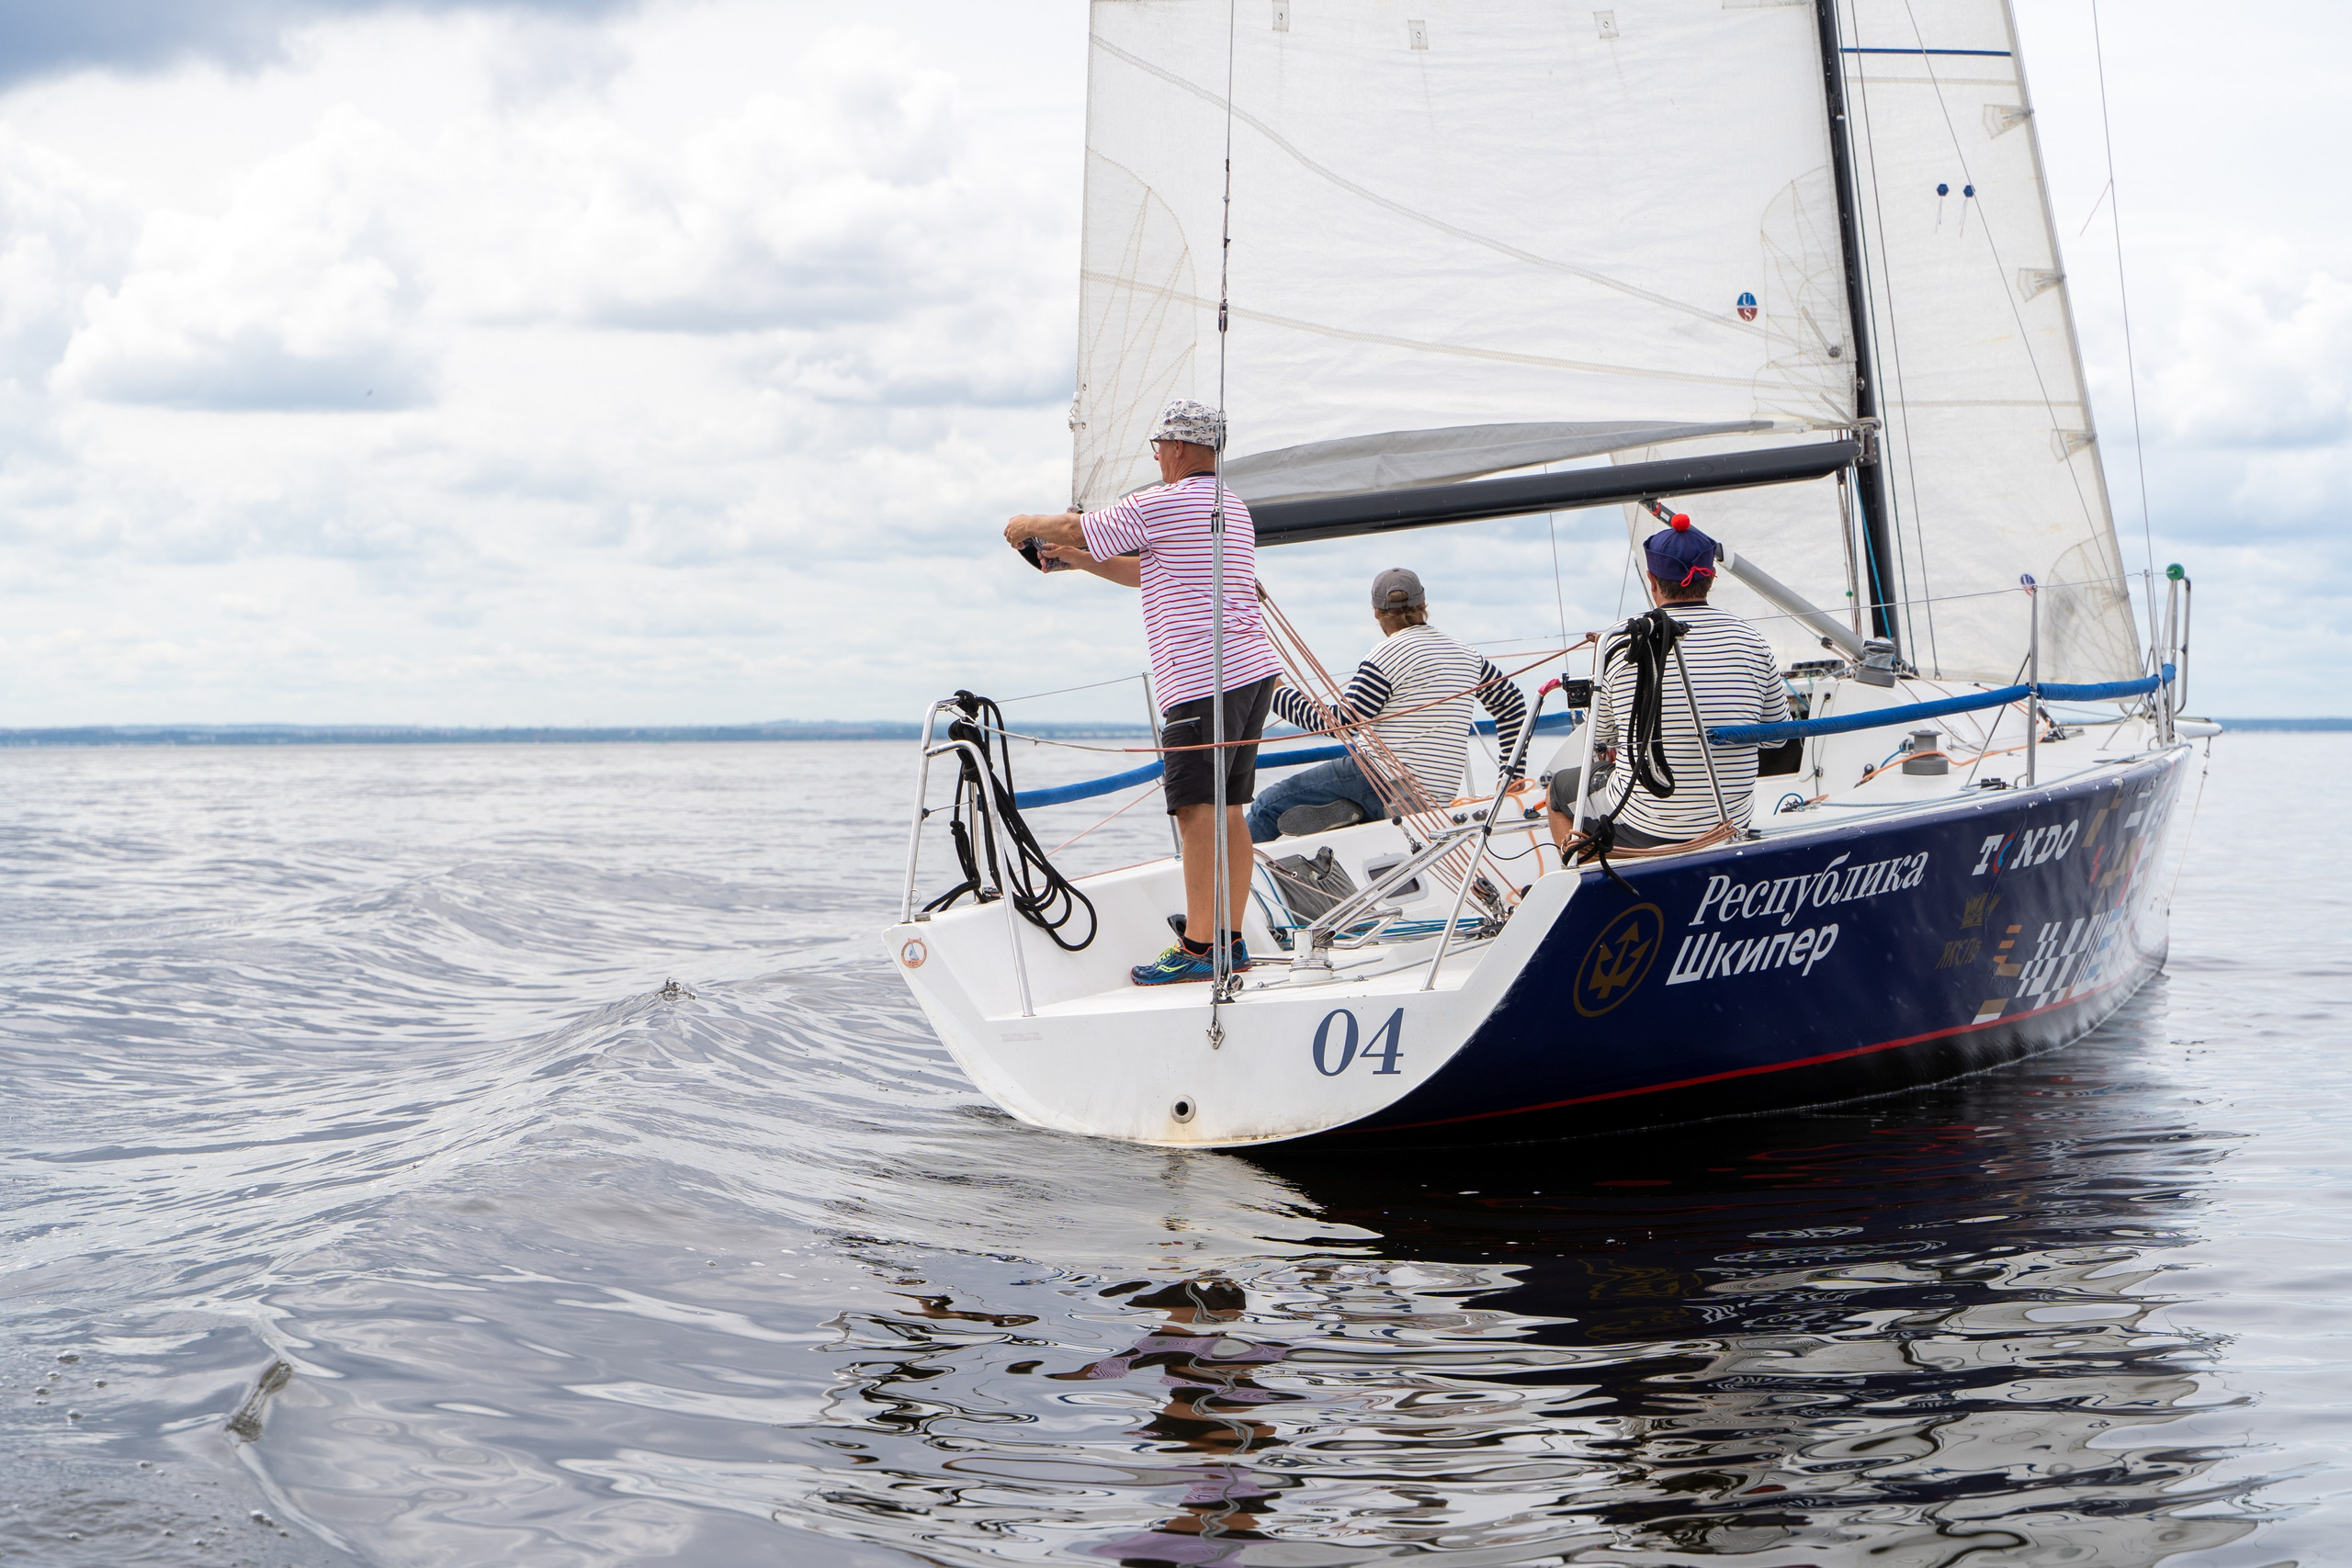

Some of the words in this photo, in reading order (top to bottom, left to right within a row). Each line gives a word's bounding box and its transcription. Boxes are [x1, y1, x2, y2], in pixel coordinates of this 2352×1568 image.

[1688, 851, 1929, 927] Республика
[1665, 922, 1839, 987] Шкипер
[1312, 1007, 1405, 1077] 04
